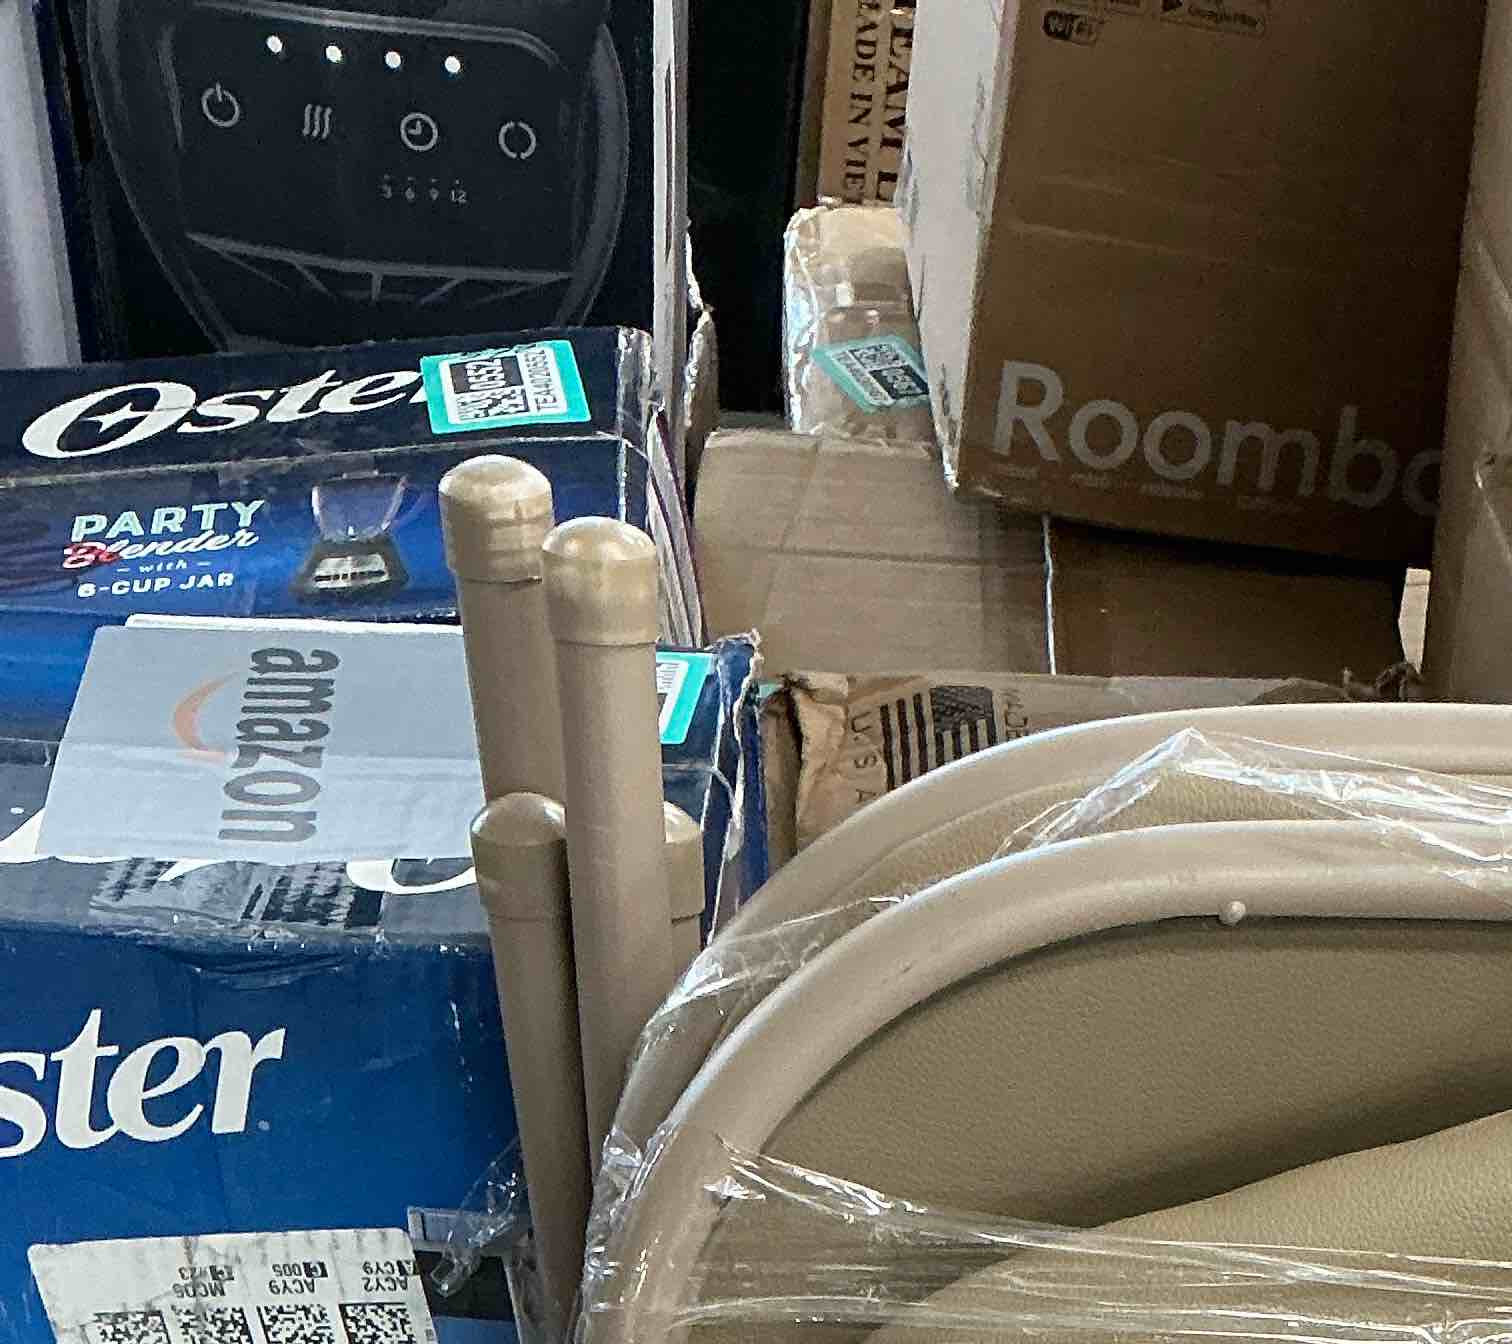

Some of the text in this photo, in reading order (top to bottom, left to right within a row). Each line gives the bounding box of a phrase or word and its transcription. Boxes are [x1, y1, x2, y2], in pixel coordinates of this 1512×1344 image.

[849, 92, 872, 126] IN
[22, 370, 426, 459] Oste
[71, 499, 265, 542] PARTY
[62, 528, 260, 569] Blender
[139, 560, 187, 573] with
[179, 573, 235, 590] JAR
[218, 646, 341, 846] amazon
[268, 1278, 316, 1295] ACY9
